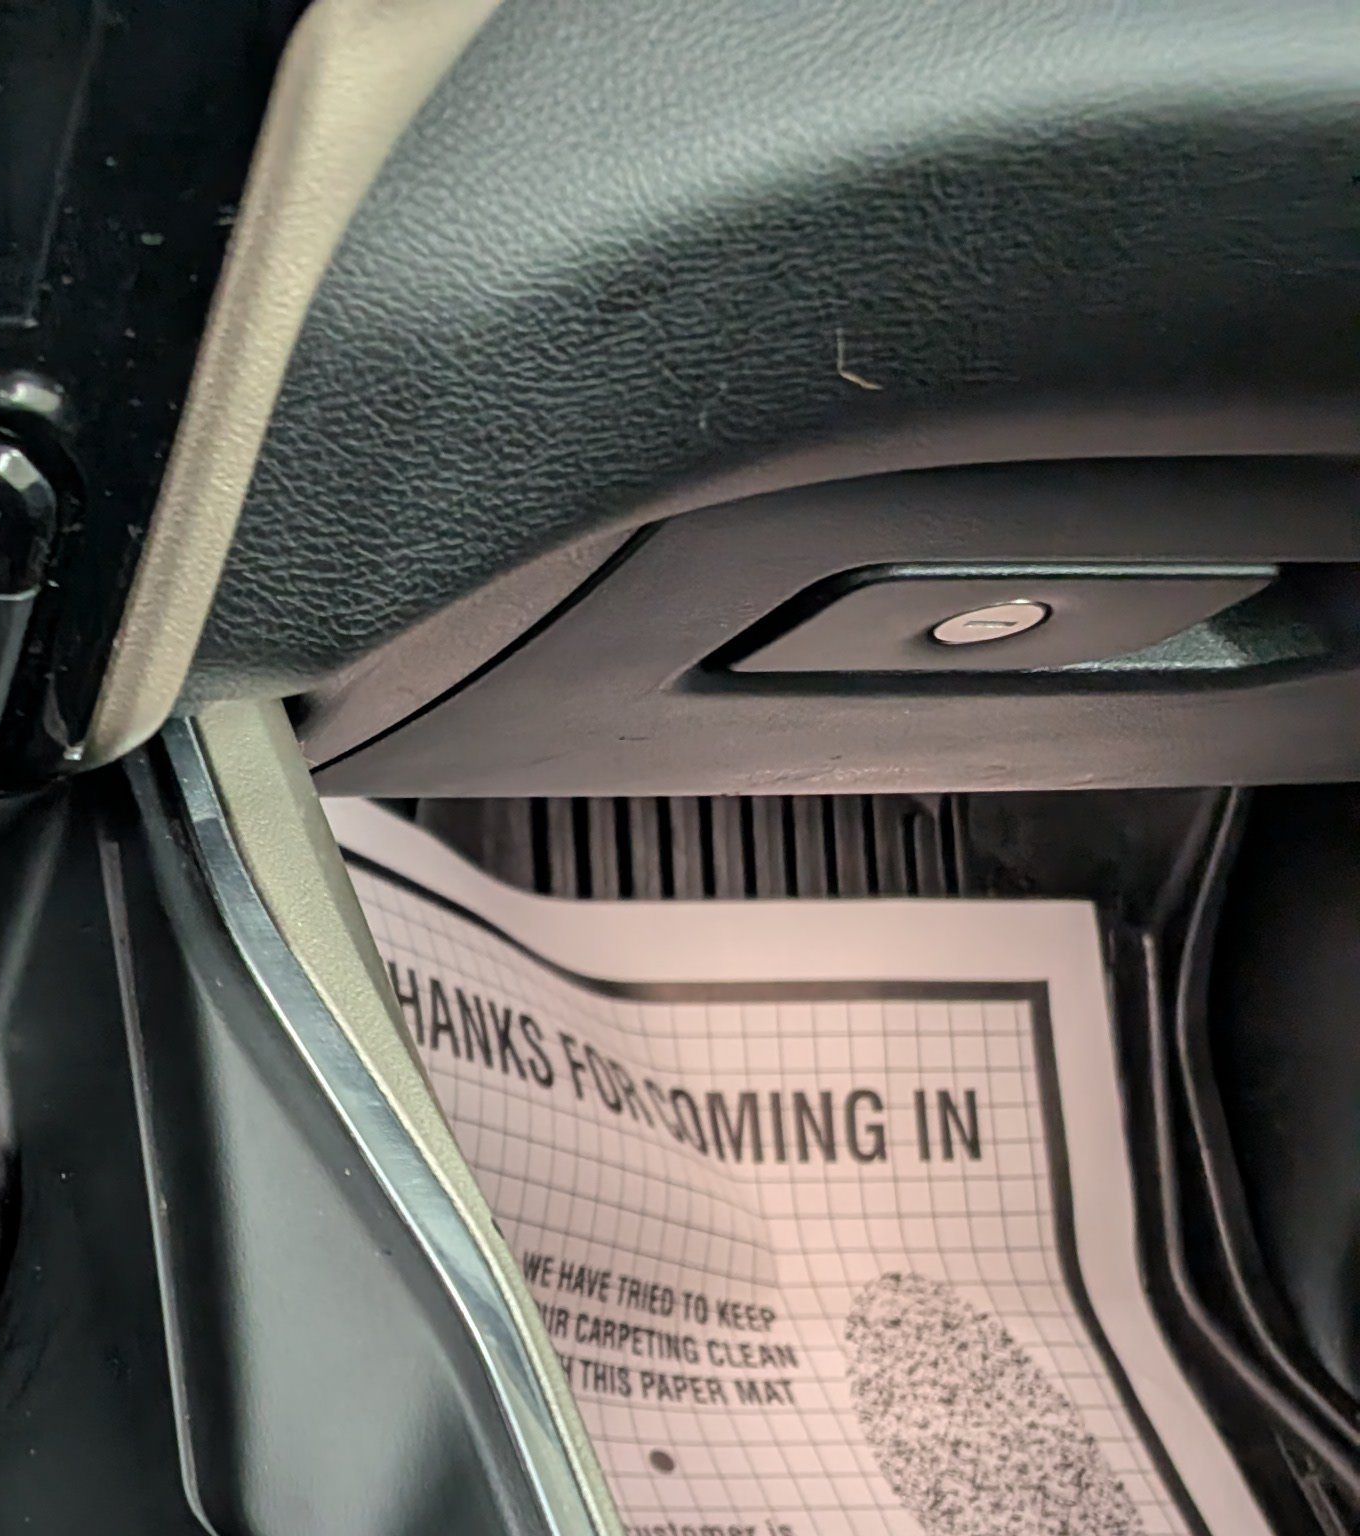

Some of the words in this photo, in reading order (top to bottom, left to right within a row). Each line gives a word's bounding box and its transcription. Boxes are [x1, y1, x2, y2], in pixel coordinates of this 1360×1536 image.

[387, 961, 554, 1089] HANKS
[558, 1030, 654, 1129] FOR
[643, 1078, 888, 1164] COMING
[913, 1088, 982, 1163] IN
[523, 1252, 554, 1288] WE
[557, 1259, 612, 1303] HAVE
[617, 1274, 675, 1317] TRIED
[682, 1291, 708, 1325] TO
[716, 1298, 776, 1332] KEEP
[537, 1302, 570, 1339] UR
[575, 1313, 700, 1365] CARPETING
[707, 1338, 799, 1369] CLEAN
[580, 1360, 632, 1397] THIS
[641, 1371, 728, 1405] PAPER
[733, 1379, 795, 1406] MAT
